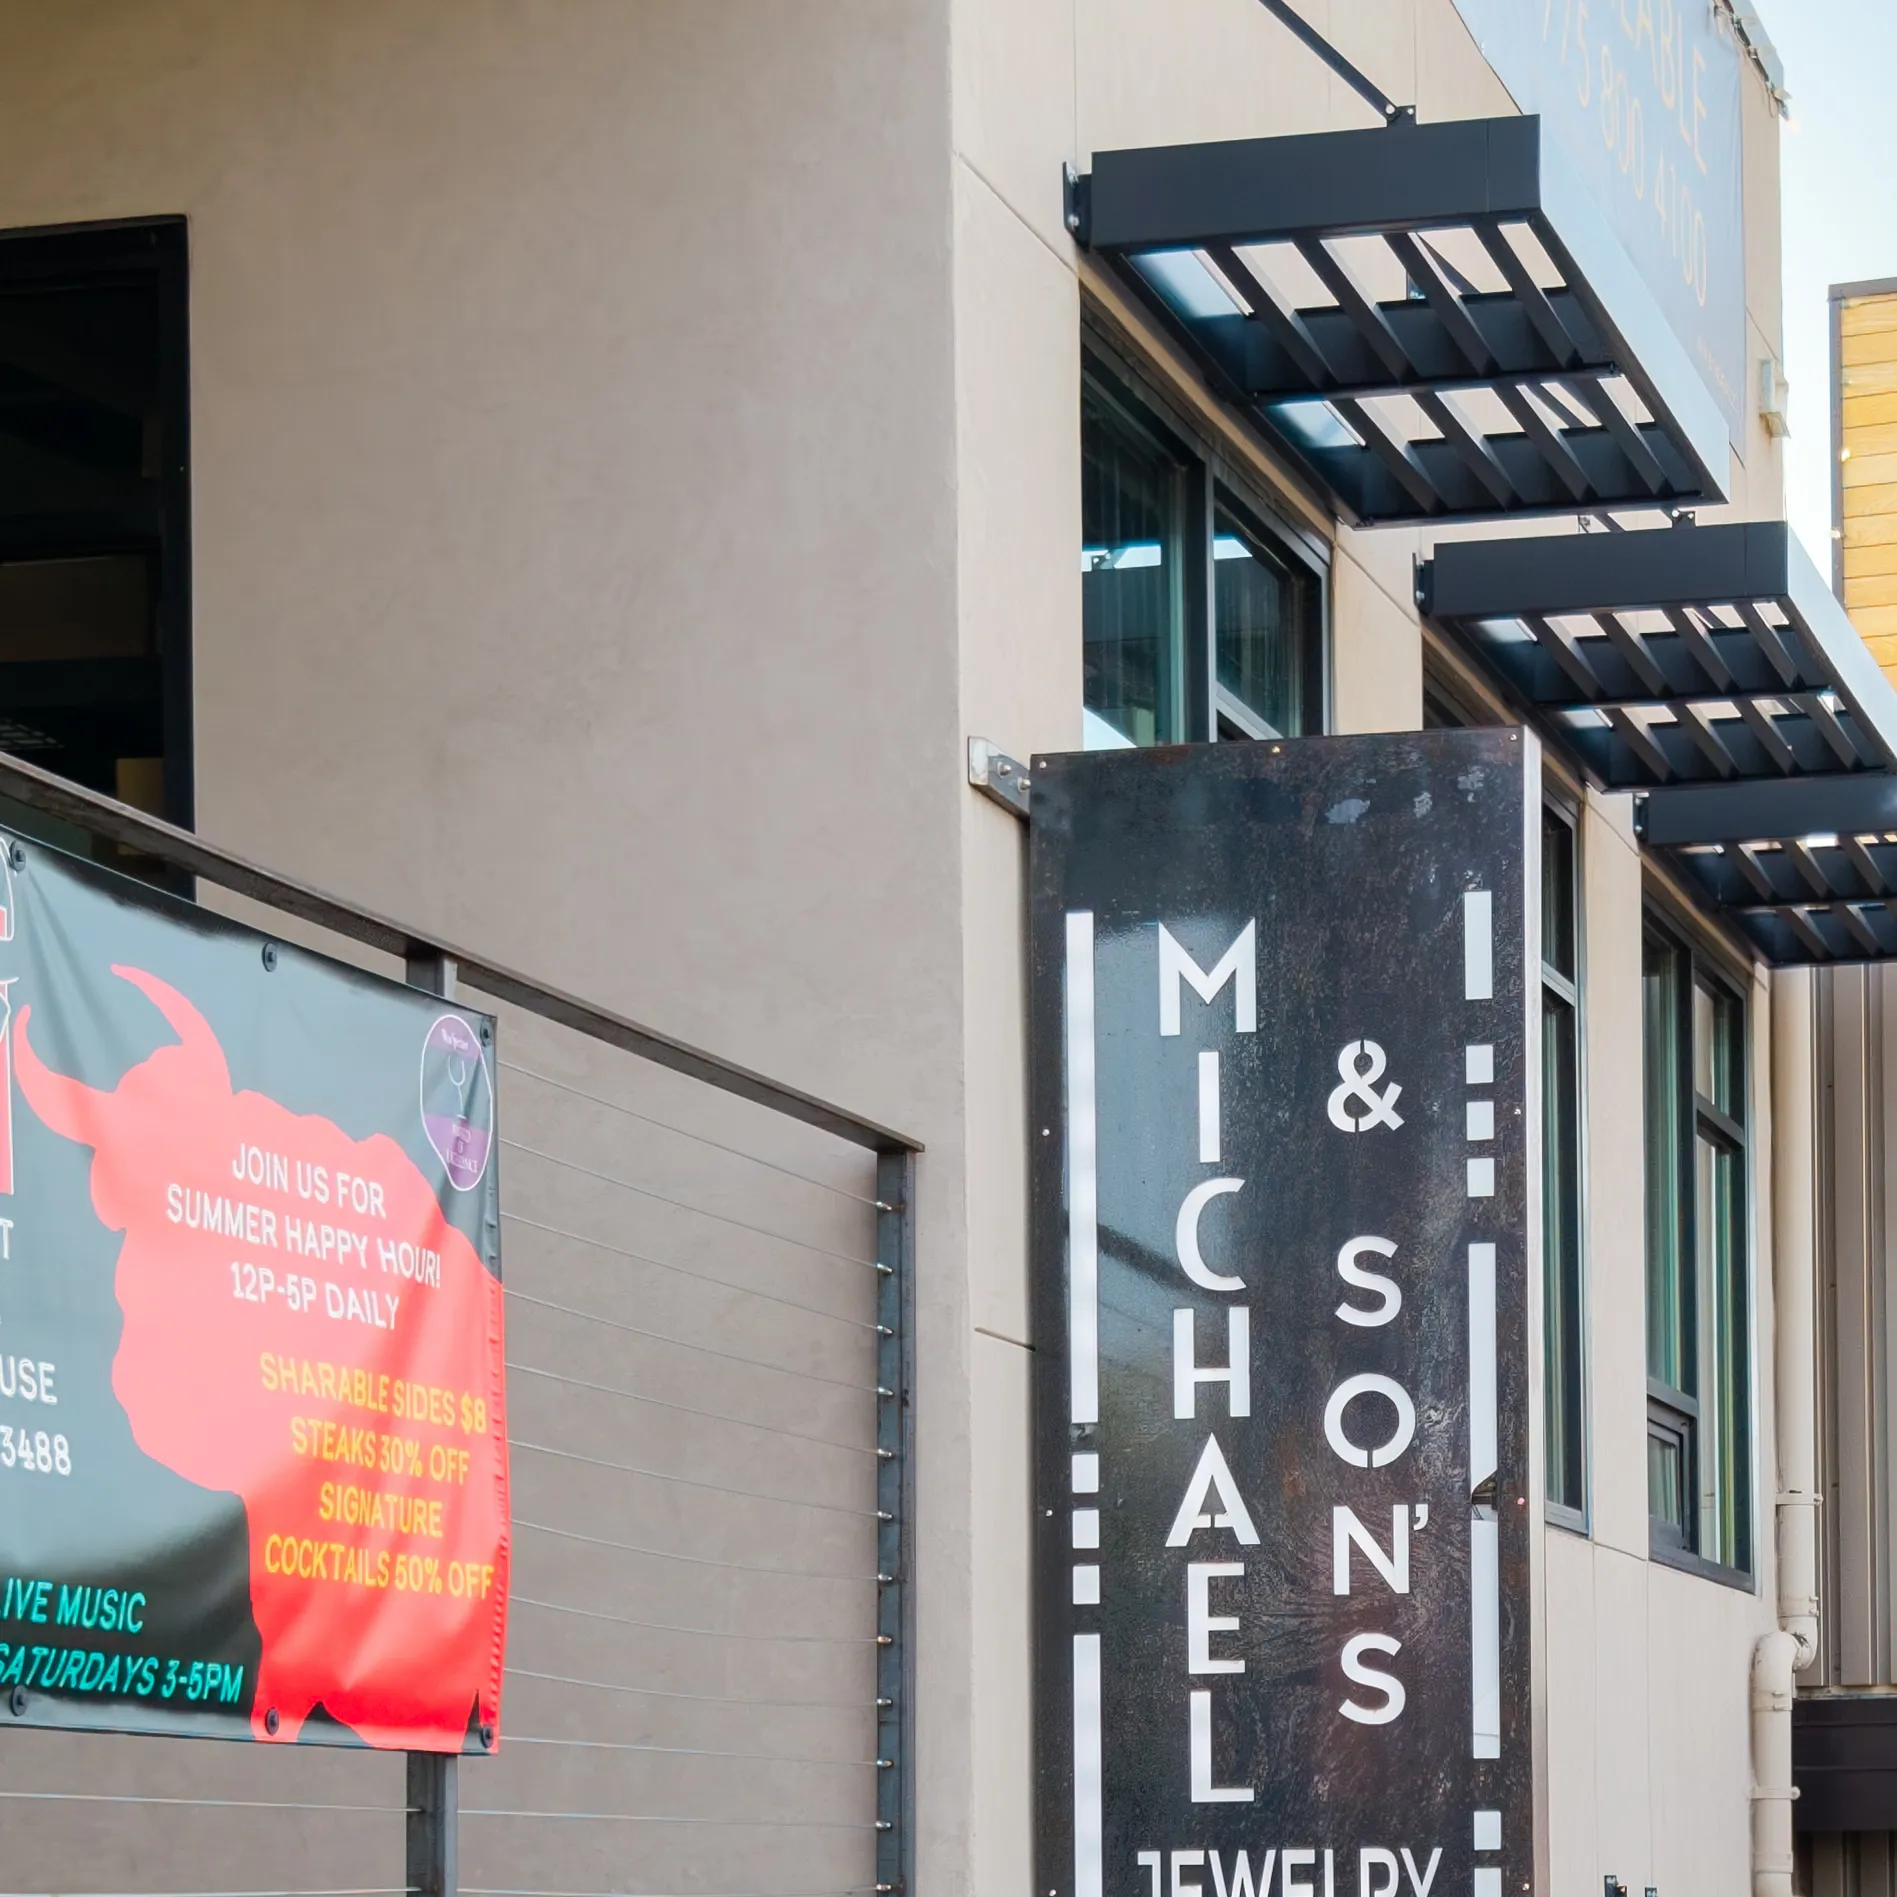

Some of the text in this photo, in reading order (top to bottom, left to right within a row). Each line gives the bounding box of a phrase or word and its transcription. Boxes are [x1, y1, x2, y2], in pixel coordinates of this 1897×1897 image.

[232, 1143, 386, 1218] JOIN US FOR
[166, 1184, 441, 1288] SUMMER HAPPY HOUR!
[231, 1261, 399, 1330] 12P-5P DAILY
[0, 1354, 58, 1406] USE
[260, 1352, 487, 1435] SHARABLE SIDES $8
[1158, 917, 1261, 1803] MICHAEL
[1324, 1039, 1429, 1725] & SON'S
[0, 1424, 72, 1477] 3488
[291, 1416, 470, 1485] STEAKS 30% OFF
[319, 1482, 443, 1538] SIGNATURE
[265, 1534, 494, 1600] COCKTAILS 50% OFF
[0, 1577, 146, 1633] IVE MUSIC
[161, 1659, 244, 1703] 3-5PM
